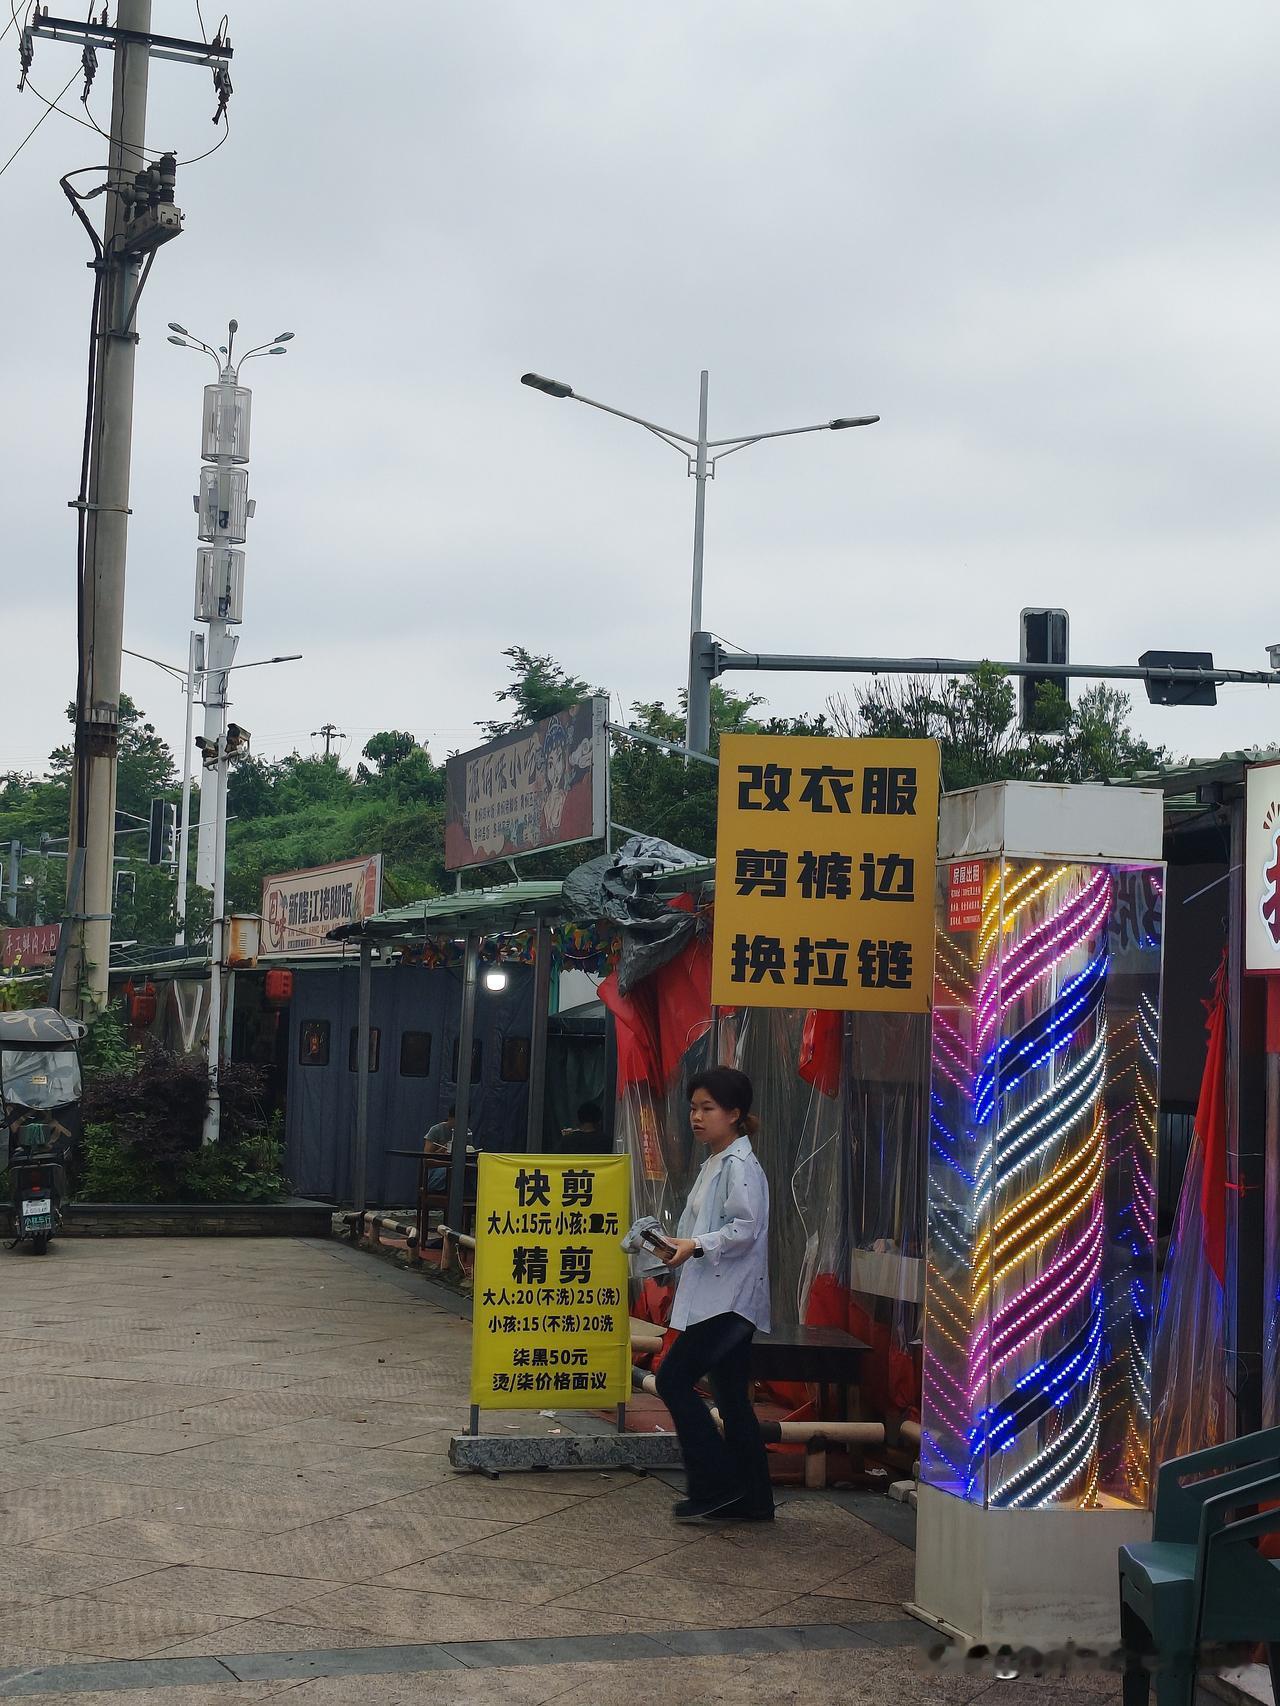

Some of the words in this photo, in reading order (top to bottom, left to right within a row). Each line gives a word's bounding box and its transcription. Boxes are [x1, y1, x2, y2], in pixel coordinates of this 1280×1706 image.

[738, 764, 918, 816] 改衣服
[734, 848, 915, 903] 剪裤边
[731, 933, 913, 990] 换拉链
[515, 1168, 596, 1208] 快剪
[487, 1210, 552, 1235] 大人:15元
[555, 1210, 619, 1236] 小孩:元
[512, 1245, 594, 1285] 精剪
[482, 1287, 622, 1306] 大人:20(不洗)25(洗)
[488, 1314, 614, 1333] 小孩:15(不洗)20洗
